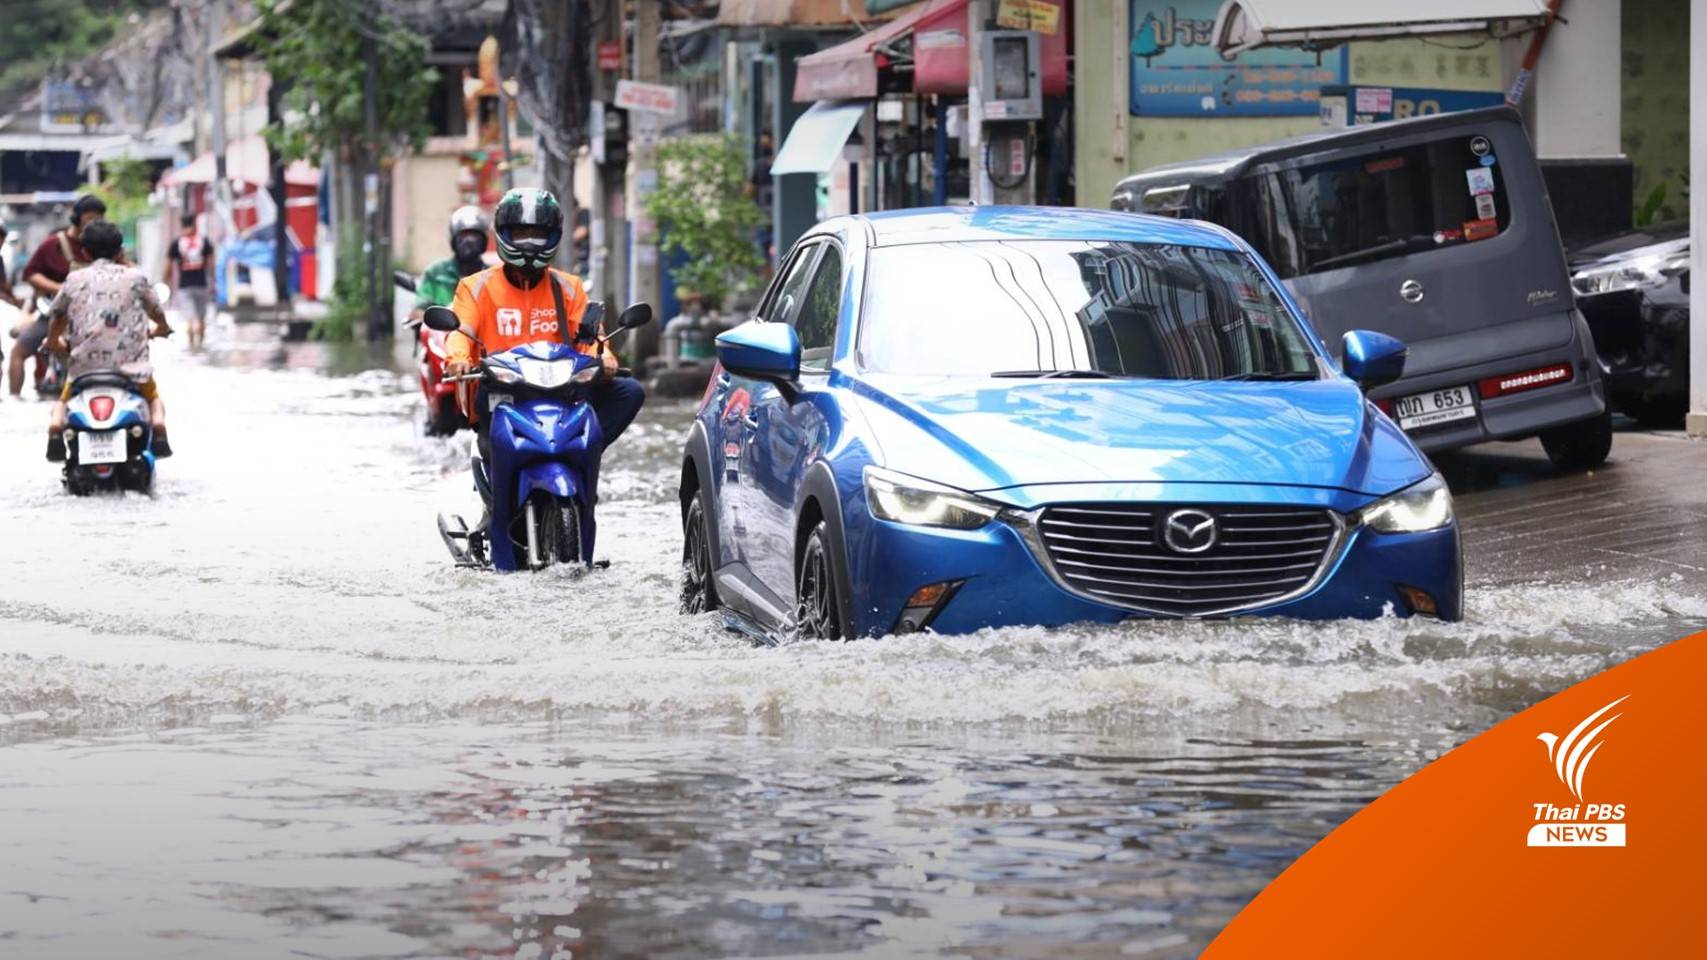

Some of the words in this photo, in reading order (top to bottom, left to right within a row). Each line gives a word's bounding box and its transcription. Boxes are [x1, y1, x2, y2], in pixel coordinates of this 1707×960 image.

[1152, 7, 1214, 47] ประ
[529, 308, 557, 320] Shop
[529, 320, 559, 336] Foo
[1433, 389, 1465, 410] 653
